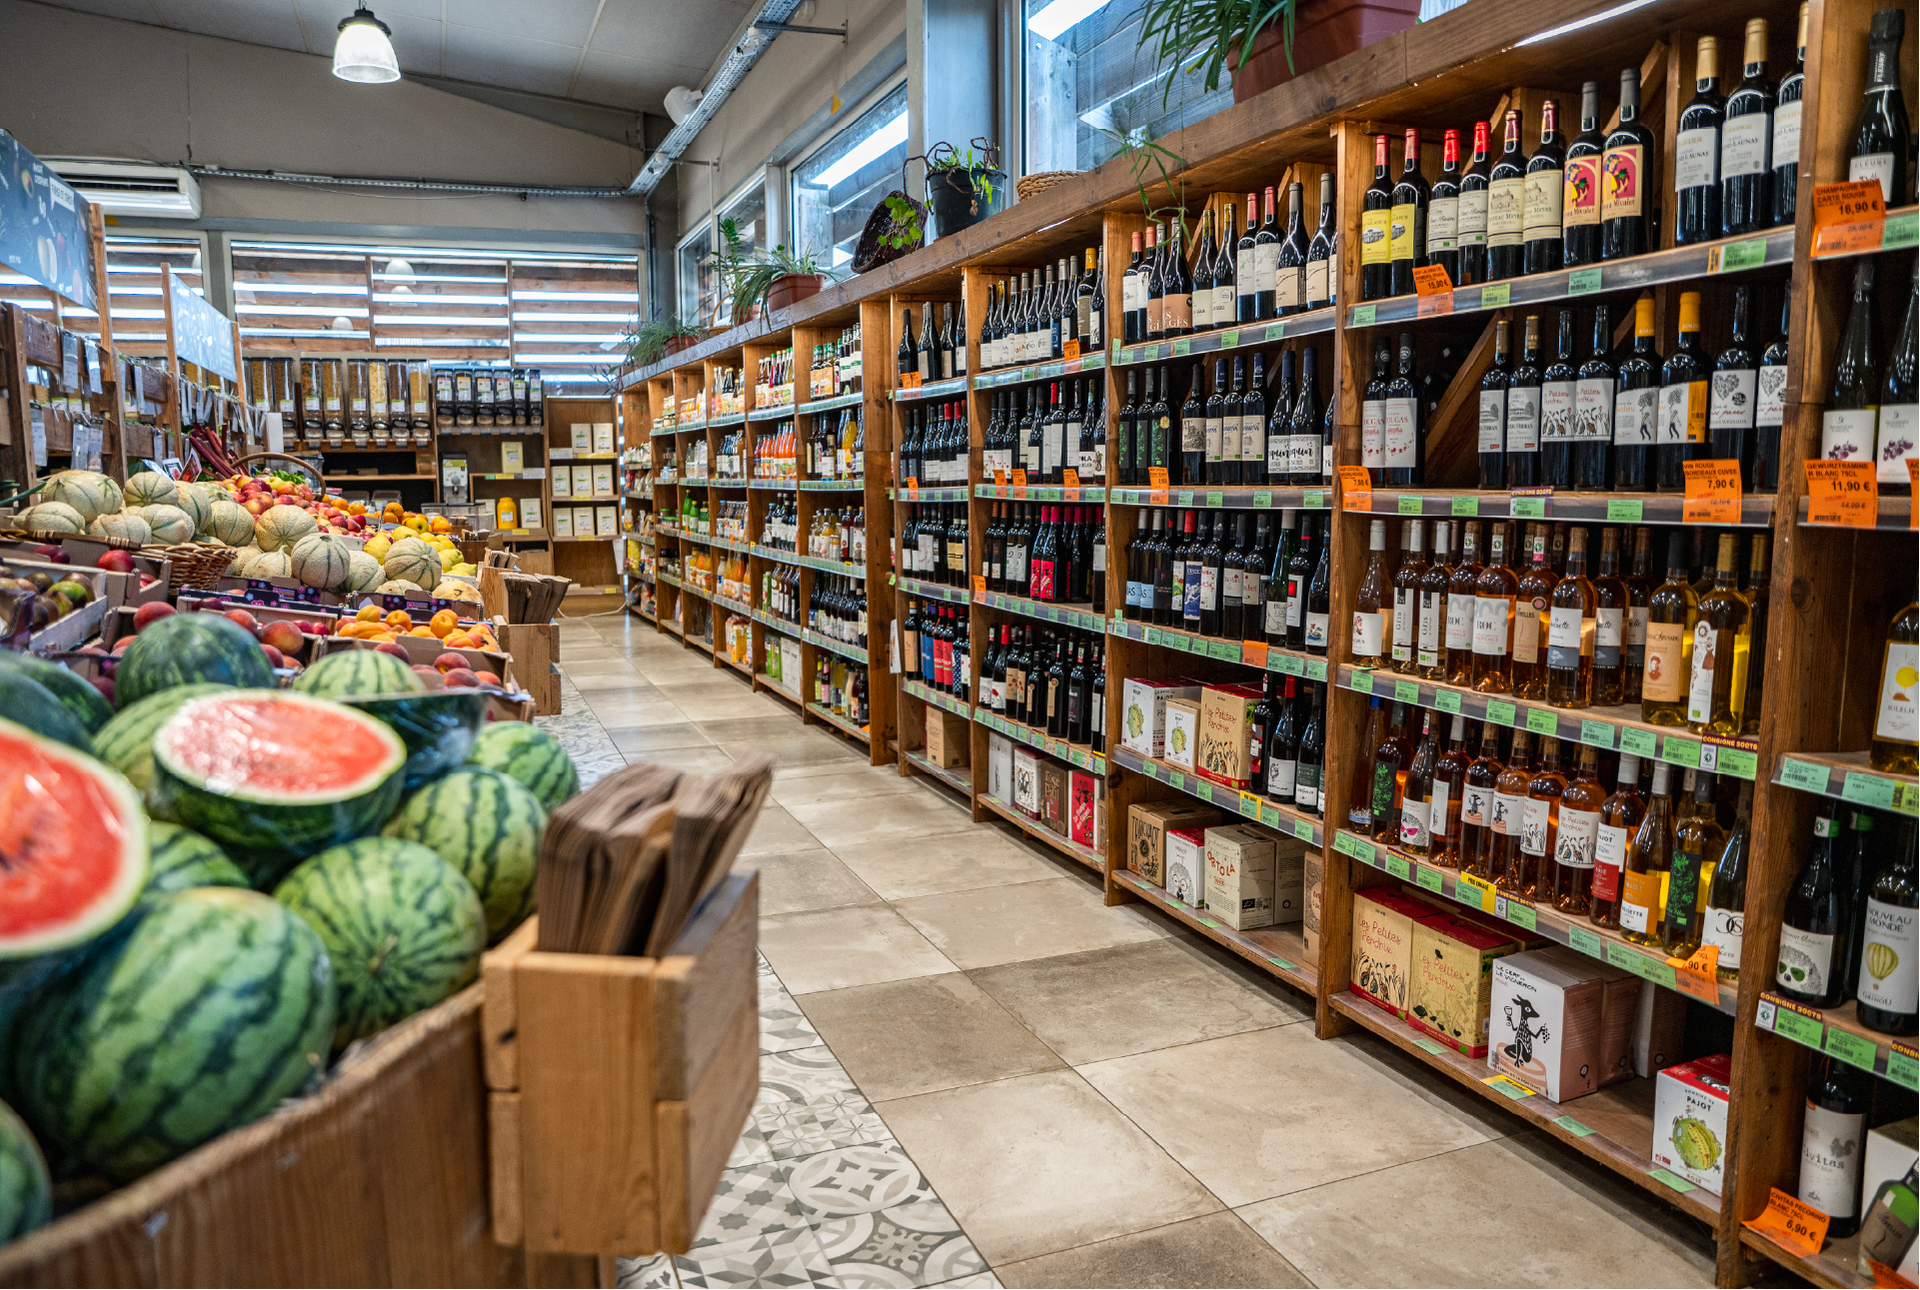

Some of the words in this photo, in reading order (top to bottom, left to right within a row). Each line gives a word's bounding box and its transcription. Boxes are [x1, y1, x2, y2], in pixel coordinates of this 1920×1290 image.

[1854, 160, 1887, 169] FLEURY
[1816, 183, 1859, 195] CHAMPAGNE
[1860, 180, 1880, 189] BRUT
[1817, 194, 1840, 204] CARTE
[1842, 191, 1866, 200] ROUGE
[1871, 200, 1879, 211] €
[1807, 462, 1869, 470] GEWURZTRAMINE
[1841, 470, 1858, 478] 75CL
[1707, 479, 1727, 490] 7,90
[1729, 479, 1735, 488] €
[1831, 481, 1861, 492] 11,90
[1863, 481, 1871, 491] €
[1476, 620, 1497, 631] ROC
[1702, 735, 1735, 747] CONSIGNE
[1207, 851, 1236, 877] ORTOLA
[1868, 907, 1912, 925] NOUVEAU
[1357, 913, 1370, 928] Les
[1372, 920, 1402, 946] Petites
[1869, 917, 1904, 933] MONDE
[1418, 948, 1431, 968] Les
[1434, 957, 1465, 984] Petites
[1702, 964, 1708, 972] €
[1504, 974, 1537, 993] VIGNERON
[1760, 992, 1797, 1011] CONSIGNE
[1686, 1096, 1712, 1112] PAJOT
[1803, 1145, 1845, 1170] ivitas
[1769, 1198, 1790, 1213] BLANC
[1790, 1209, 1804, 1221] 75CL
[1770, 1192, 1794, 1207] CIVITAS
[1794, 1203, 1826, 1223] PECORINO
[1786, 1219, 1807, 1236] 6,90
[1809, 1231, 1817, 1242] €
